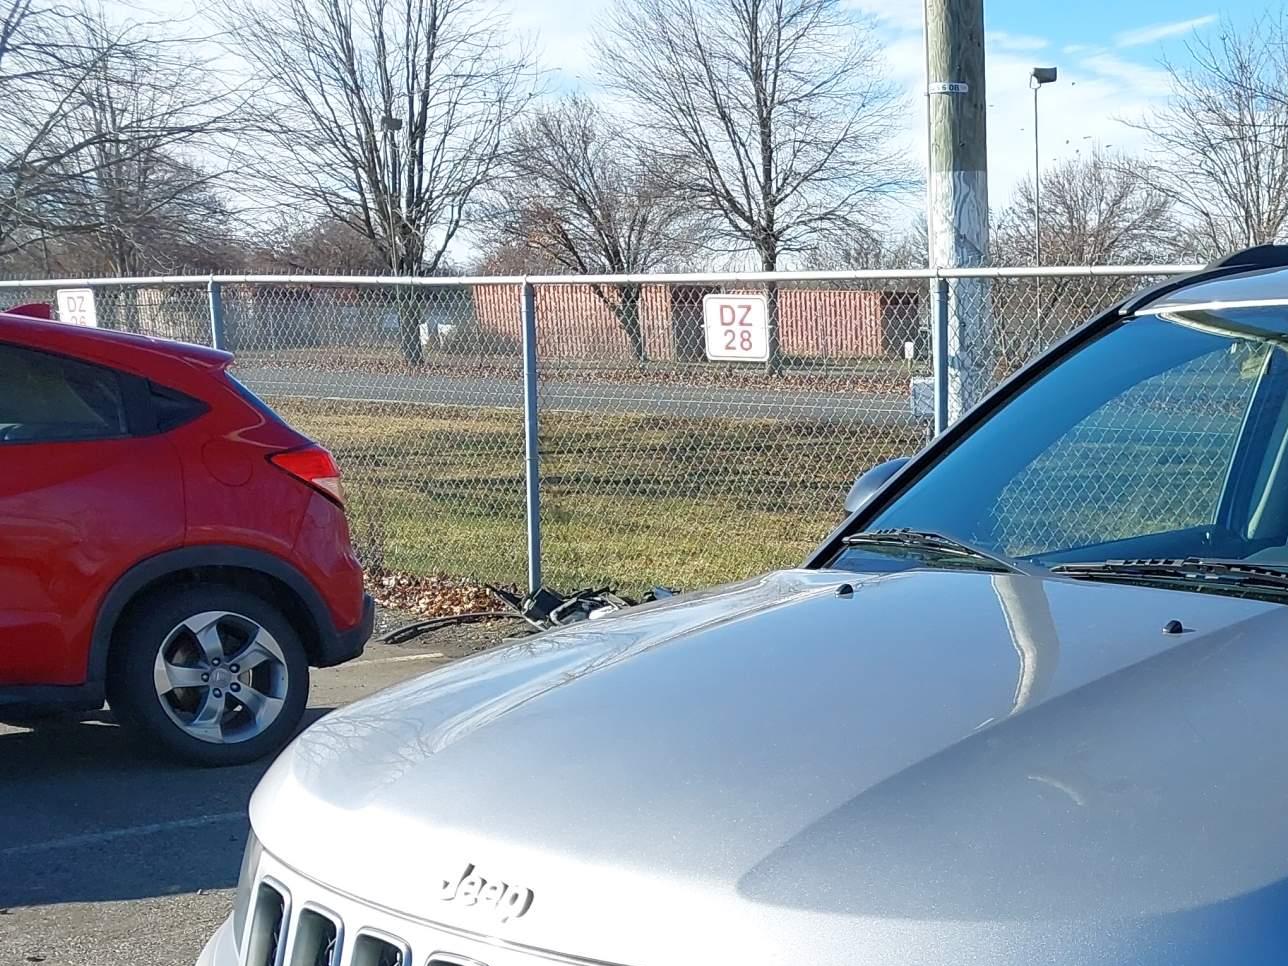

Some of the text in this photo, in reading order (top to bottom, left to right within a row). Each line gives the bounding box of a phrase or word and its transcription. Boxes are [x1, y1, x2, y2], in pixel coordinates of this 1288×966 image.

[67, 296, 86, 313] DZ
[720, 304, 753, 327] DZ
[724, 329, 753, 351] 28
[440, 862, 535, 924] Jeep
